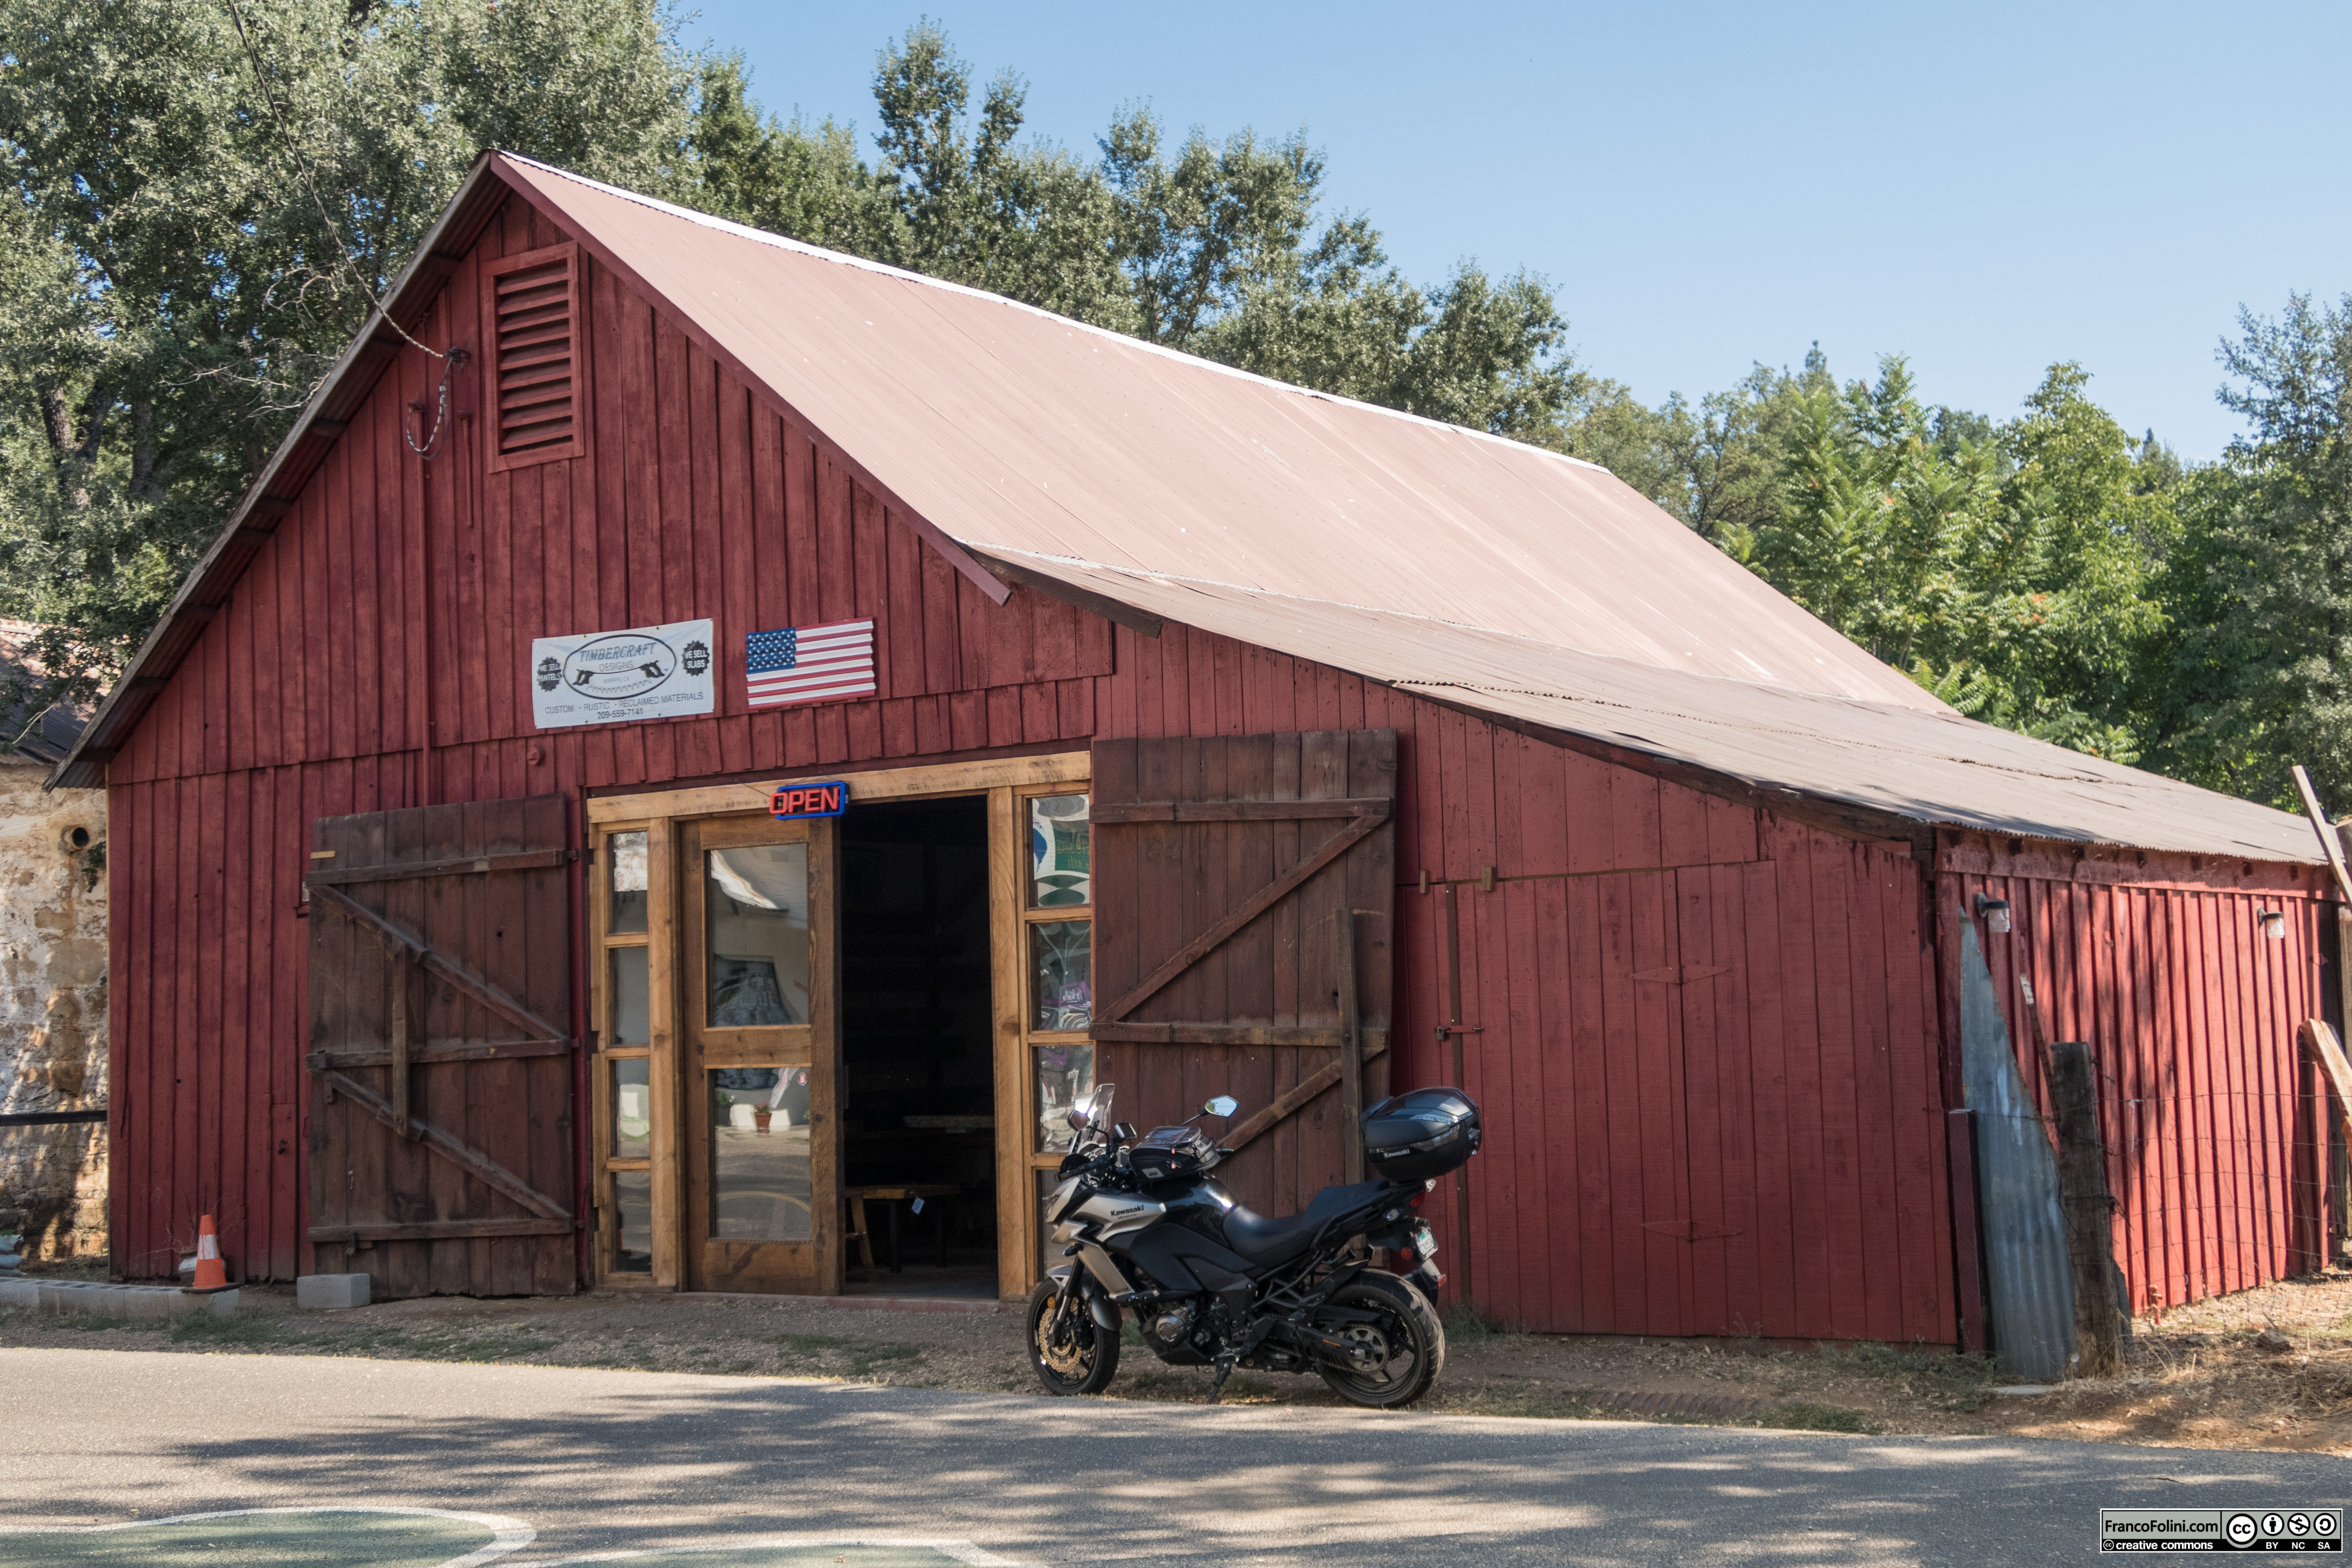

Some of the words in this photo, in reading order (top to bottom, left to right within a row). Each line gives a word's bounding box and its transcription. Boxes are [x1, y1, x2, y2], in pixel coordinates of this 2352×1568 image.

[579, 642, 657, 662] TIMBERCRAFT
[684, 650, 692, 659] WE
[693, 649, 707, 658] SELL
[599, 661, 633, 672] DESIGNS
[687, 659, 705, 668] SLABS
[537, 673, 561, 682] MANTELS
[545, 704, 573, 714] CUSTOM
[584, 702, 609, 711] RUSTIC
[619, 696, 658, 707] RECLAIMED
[662, 692, 703, 703] MATERIALS
[597, 708, 643, 720] 209-559-7141
[769, 788, 838, 814] OPEN
[1384, 1148, 1410, 1158] Kawasaki
[1110, 1205, 1144, 1217] Kawasaki
